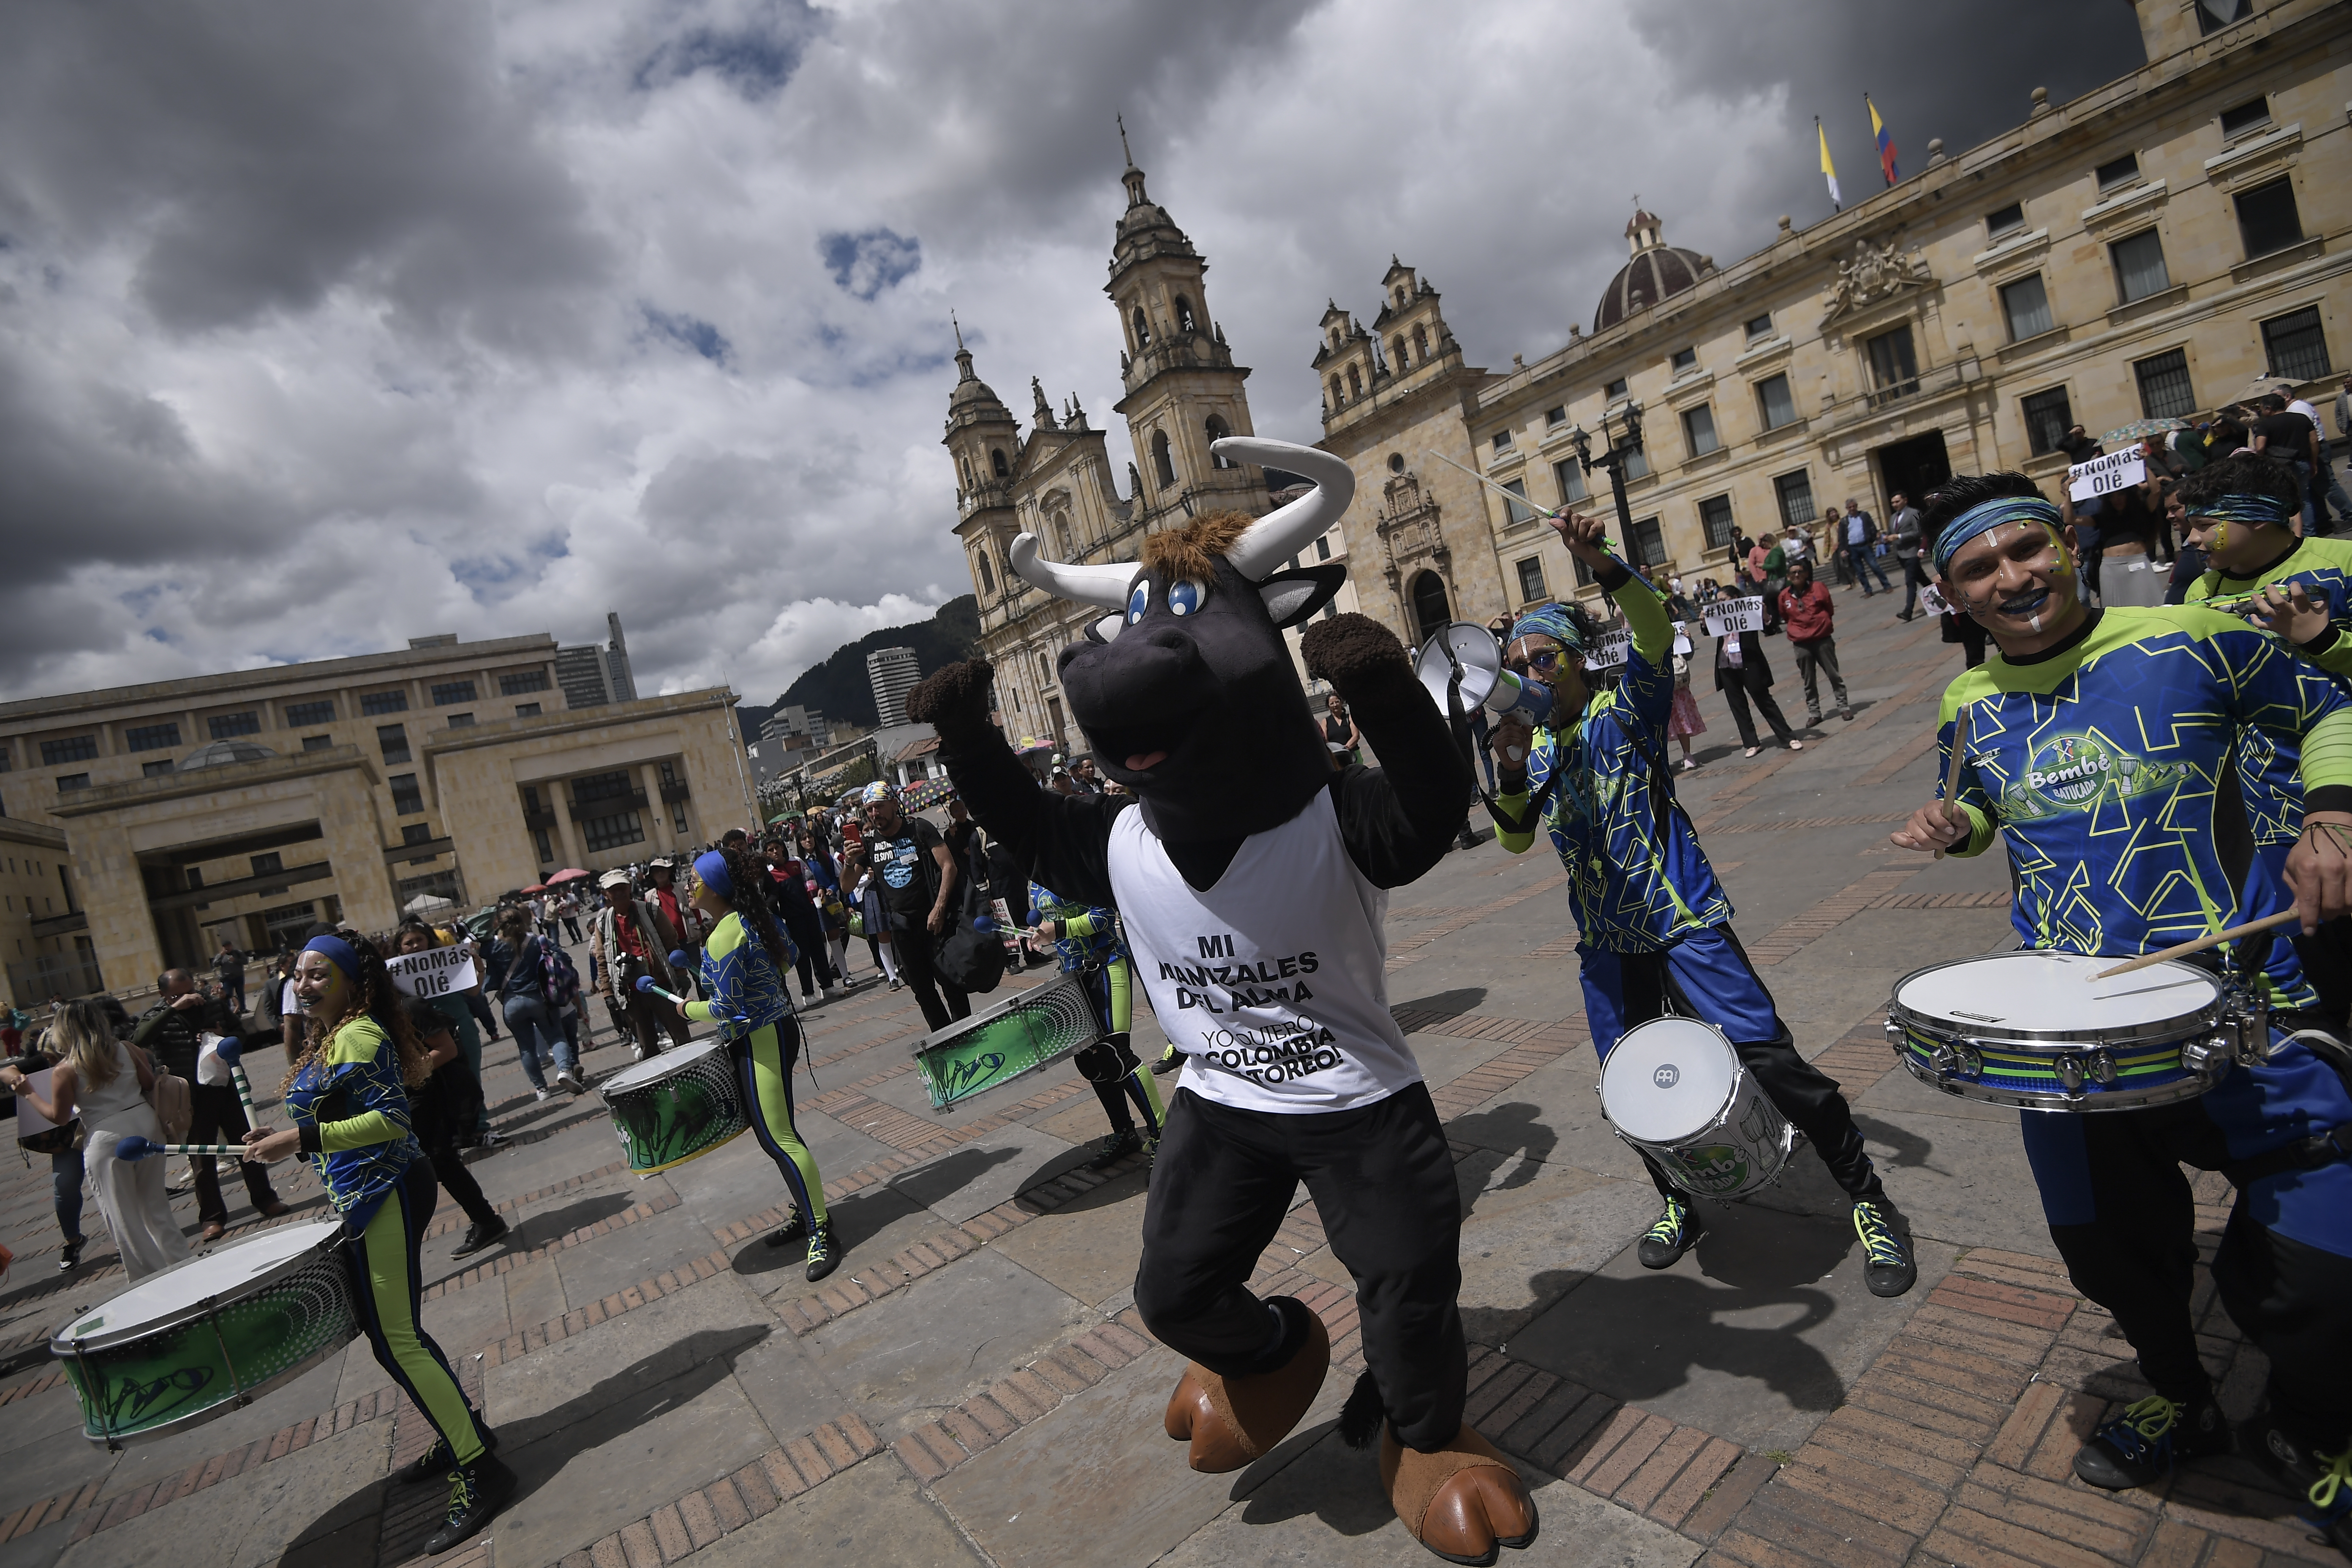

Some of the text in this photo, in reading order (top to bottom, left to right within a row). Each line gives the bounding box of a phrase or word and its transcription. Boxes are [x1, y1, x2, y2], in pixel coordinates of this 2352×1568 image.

[2072, 449, 2142, 477] #NoMás
[2093, 470, 2122, 493] Olé
[1706, 598, 1760, 618] #NoMás
[1724, 614, 1748, 632] Olé
[2025, 753, 2112, 789] Bembé
[2053, 779, 2096, 800] BATUCADA
[874, 853, 880, 863] EL
[880, 850, 893, 861] SUYO
[1197, 934, 1235, 958] MI
[388, 947, 469, 976] #NoMás
[414, 970, 450, 997] Olé
[1232, 980, 1313, 1012] ALMA
[1176, 987, 1224, 1013] DEL
[1201, 1014, 1314, 1048] YO QUIERO
